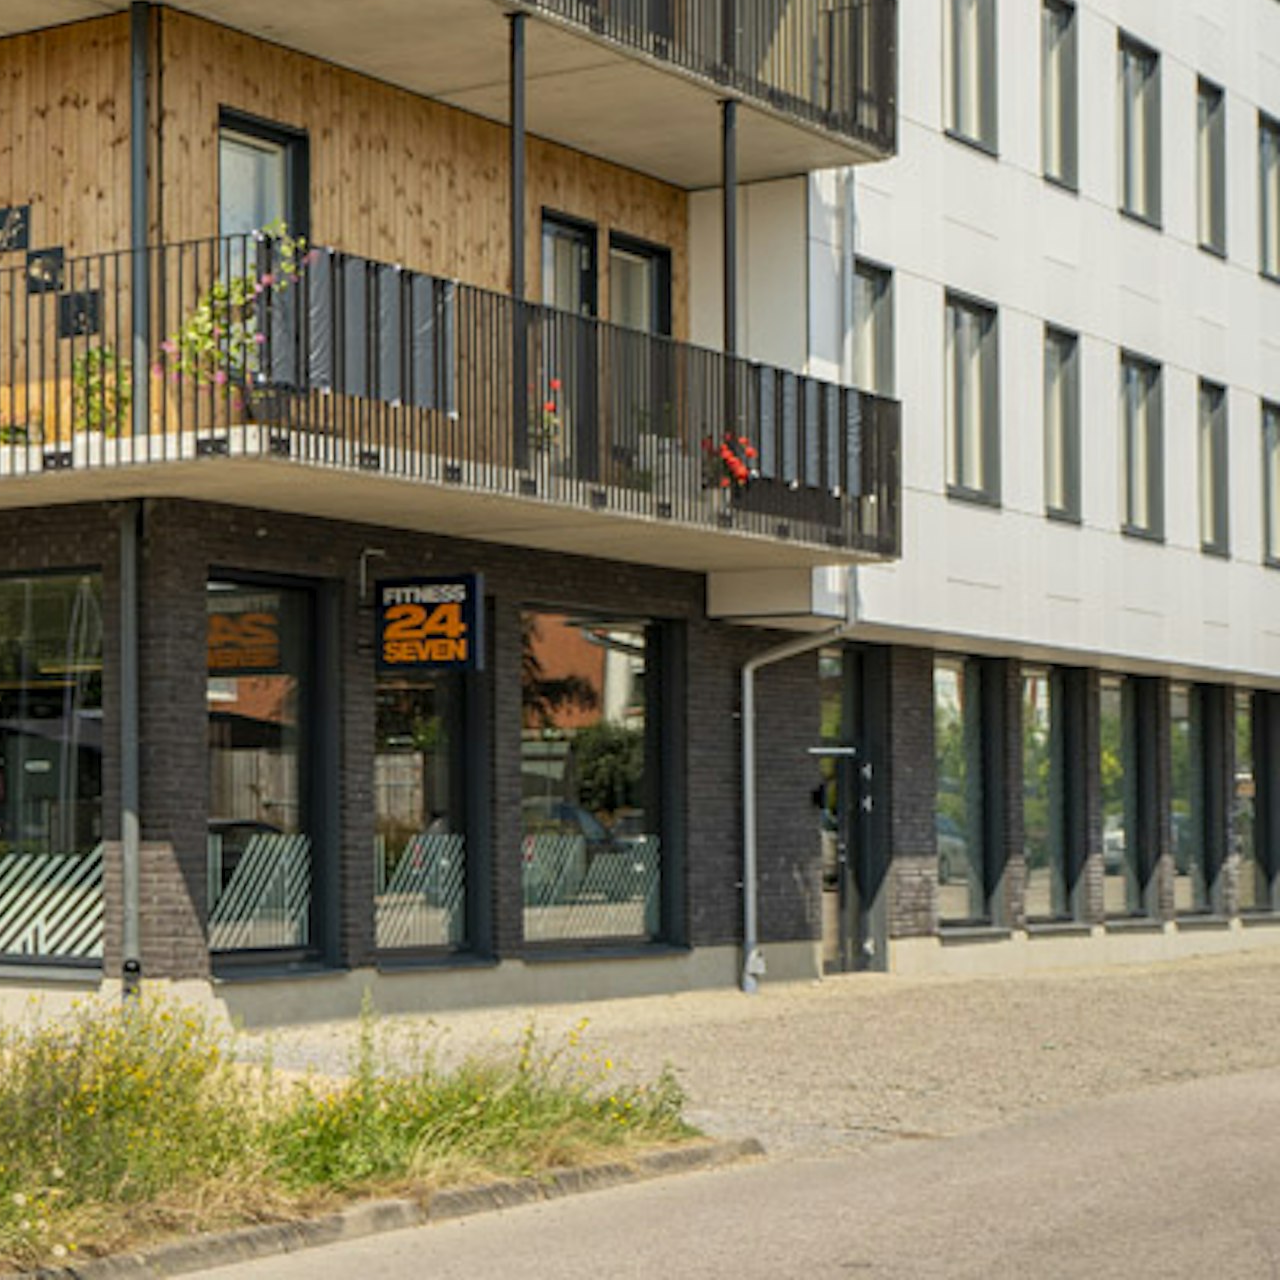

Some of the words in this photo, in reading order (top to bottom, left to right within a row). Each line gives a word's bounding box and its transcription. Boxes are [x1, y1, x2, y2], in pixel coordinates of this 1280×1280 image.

[383, 584, 466, 606] FITNESS
[383, 603, 468, 640] 24
[383, 638, 467, 663] SEVEN
